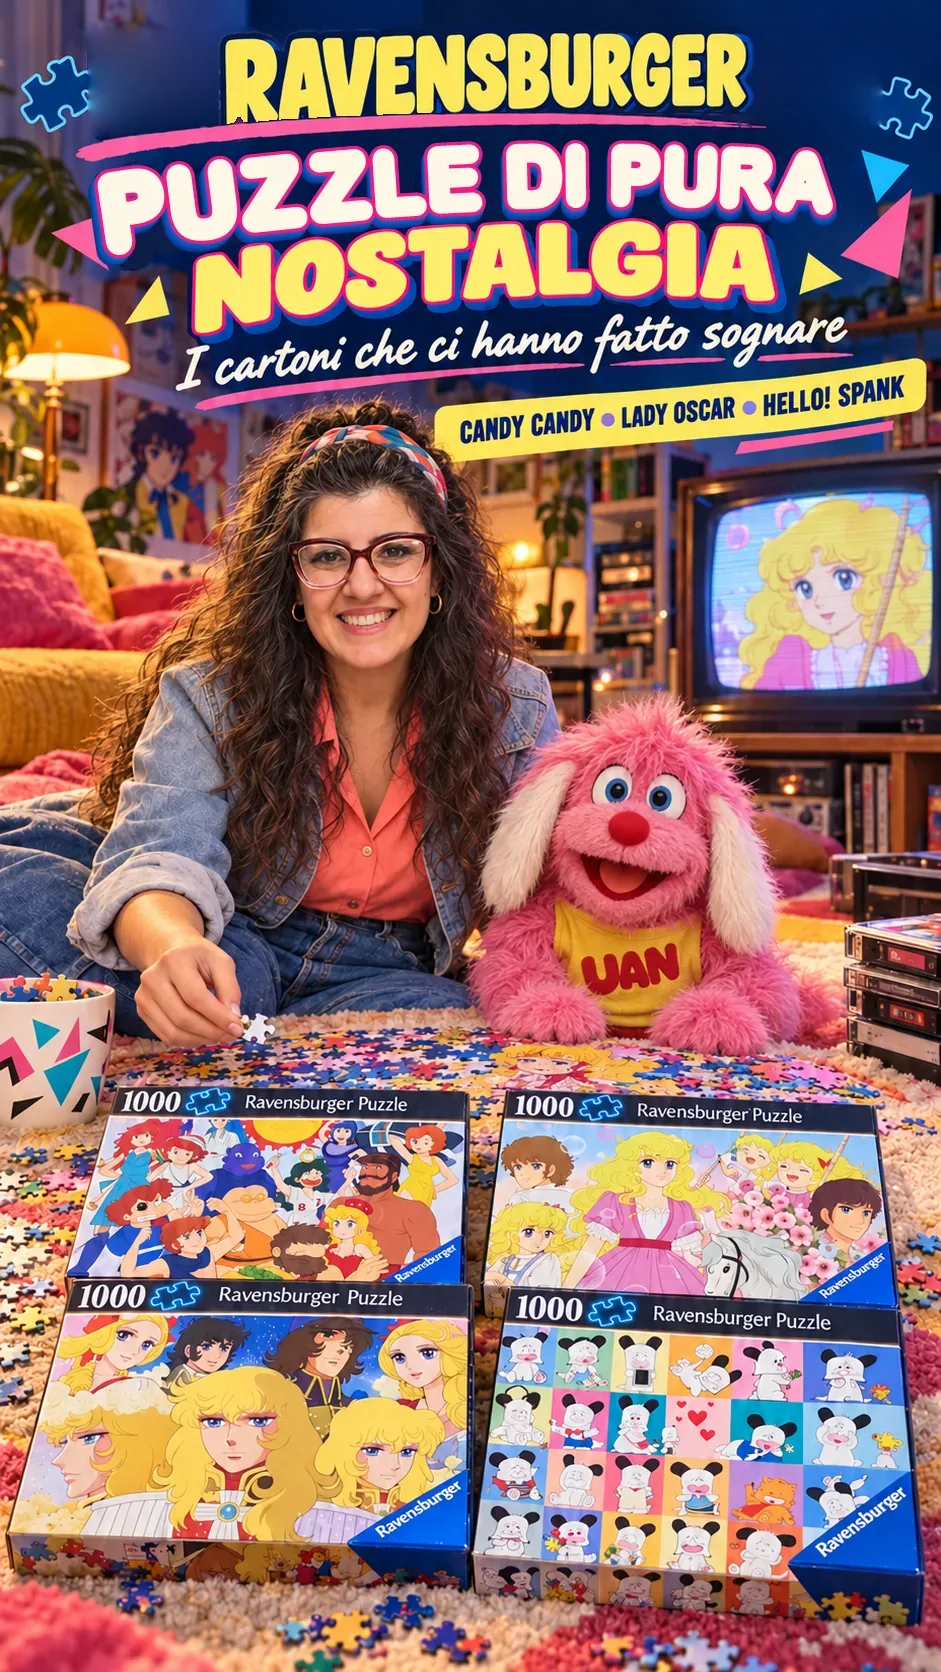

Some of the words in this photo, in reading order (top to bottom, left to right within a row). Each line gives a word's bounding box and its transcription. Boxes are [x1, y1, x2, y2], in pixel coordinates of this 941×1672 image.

[120, 1091, 181, 1113] 1000
[245, 1093, 354, 1113] Ravensburger
[358, 1097, 408, 1112] Puzzle
[514, 1095, 574, 1118] 1000
[637, 1102, 749, 1124] Ravensburger
[752, 1107, 803, 1124] Puzzle
[298, 1203, 306, 1211] 8
[394, 1243, 458, 1284] Ravensburger
[818, 1251, 886, 1300] Ravensburger
[77, 1284, 146, 1309] 1000
[218, 1286, 340, 1306] Ravensburger
[347, 1289, 403, 1307] Puzzle
[516, 1294, 583, 1322] 1000
[653, 1305, 772, 1329] Ravensburger
[776, 1312, 832, 1331] Puzzle
[374, 1480, 463, 1539] Ravensburger
[814, 1485, 908, 1558] Ravensburger
